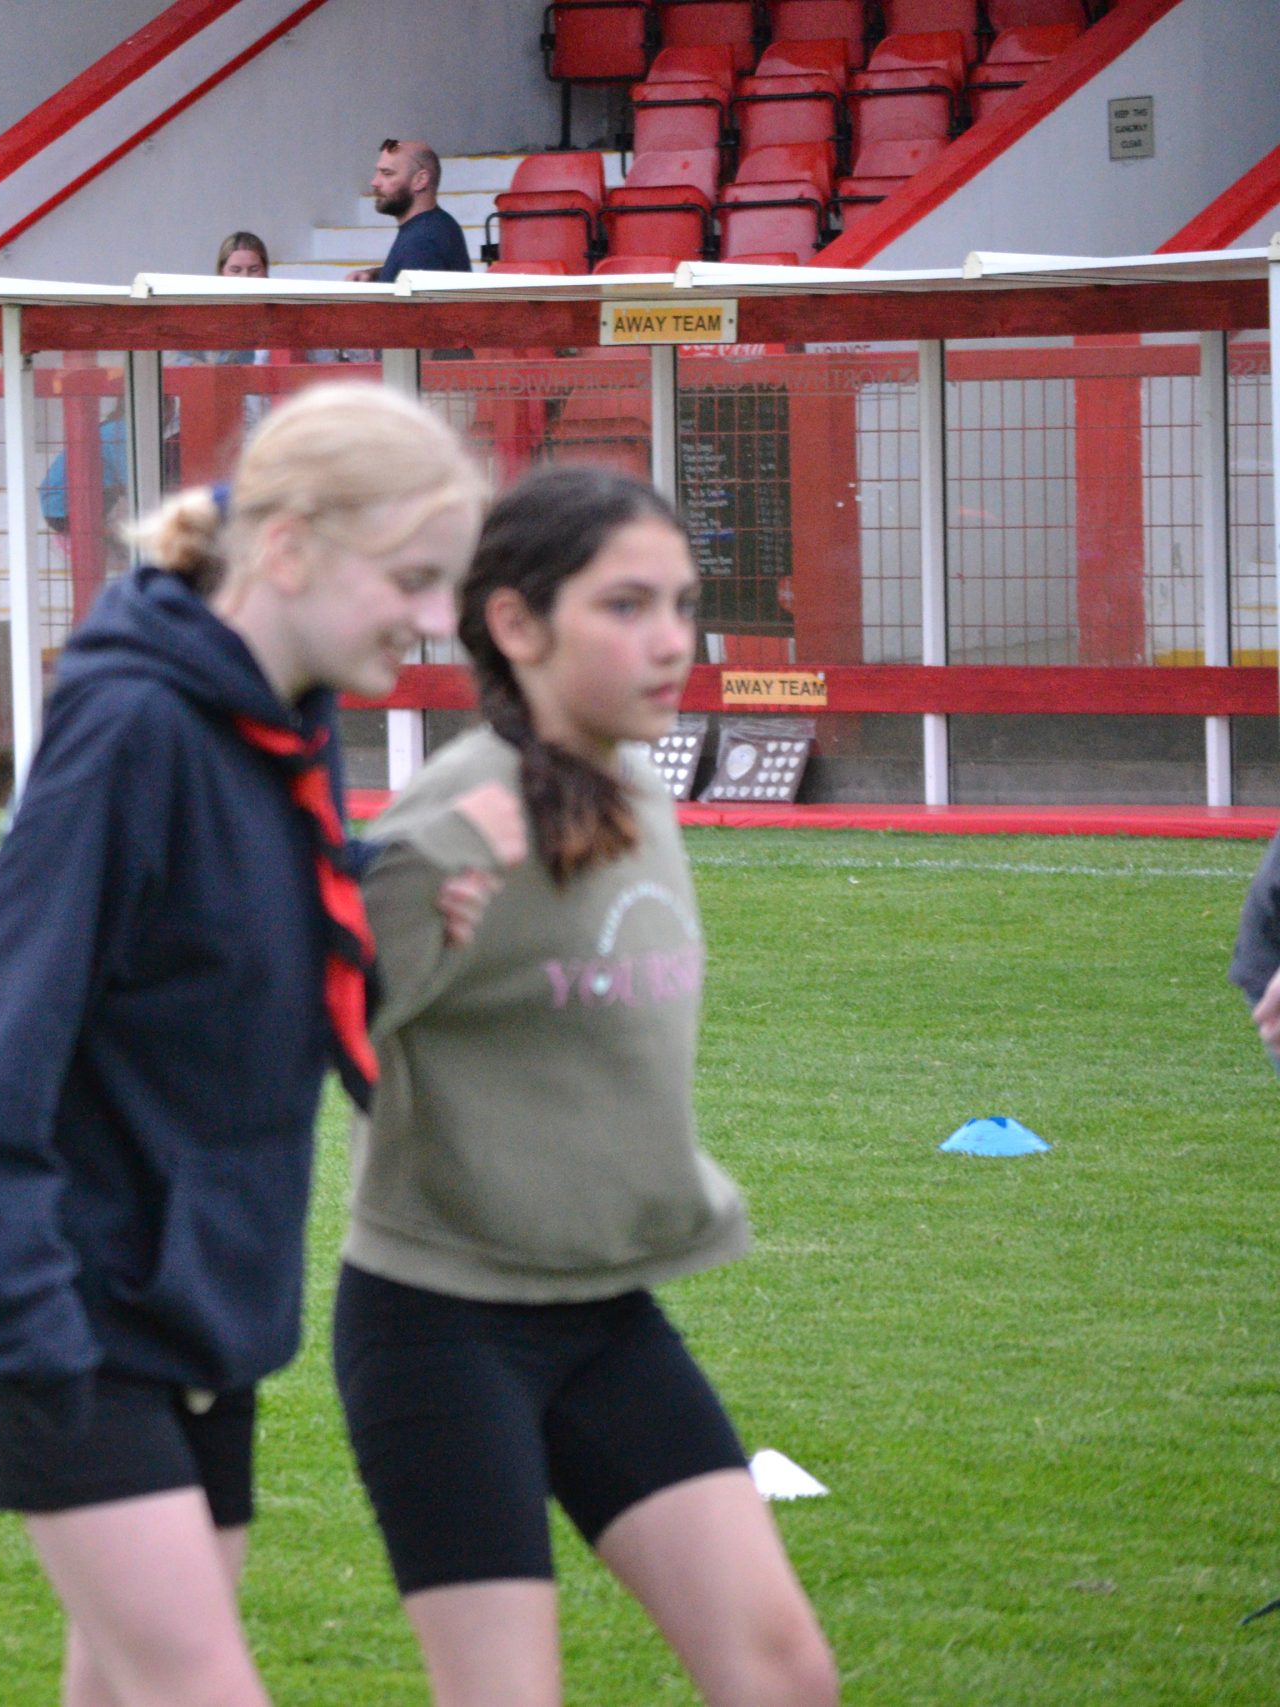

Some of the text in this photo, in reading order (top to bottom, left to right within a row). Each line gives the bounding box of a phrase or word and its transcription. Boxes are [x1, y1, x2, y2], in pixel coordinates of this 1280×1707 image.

[614, 315, 721, 333] AWAY TEAM
[724, 679, 826, 697] AWAY TEAM
